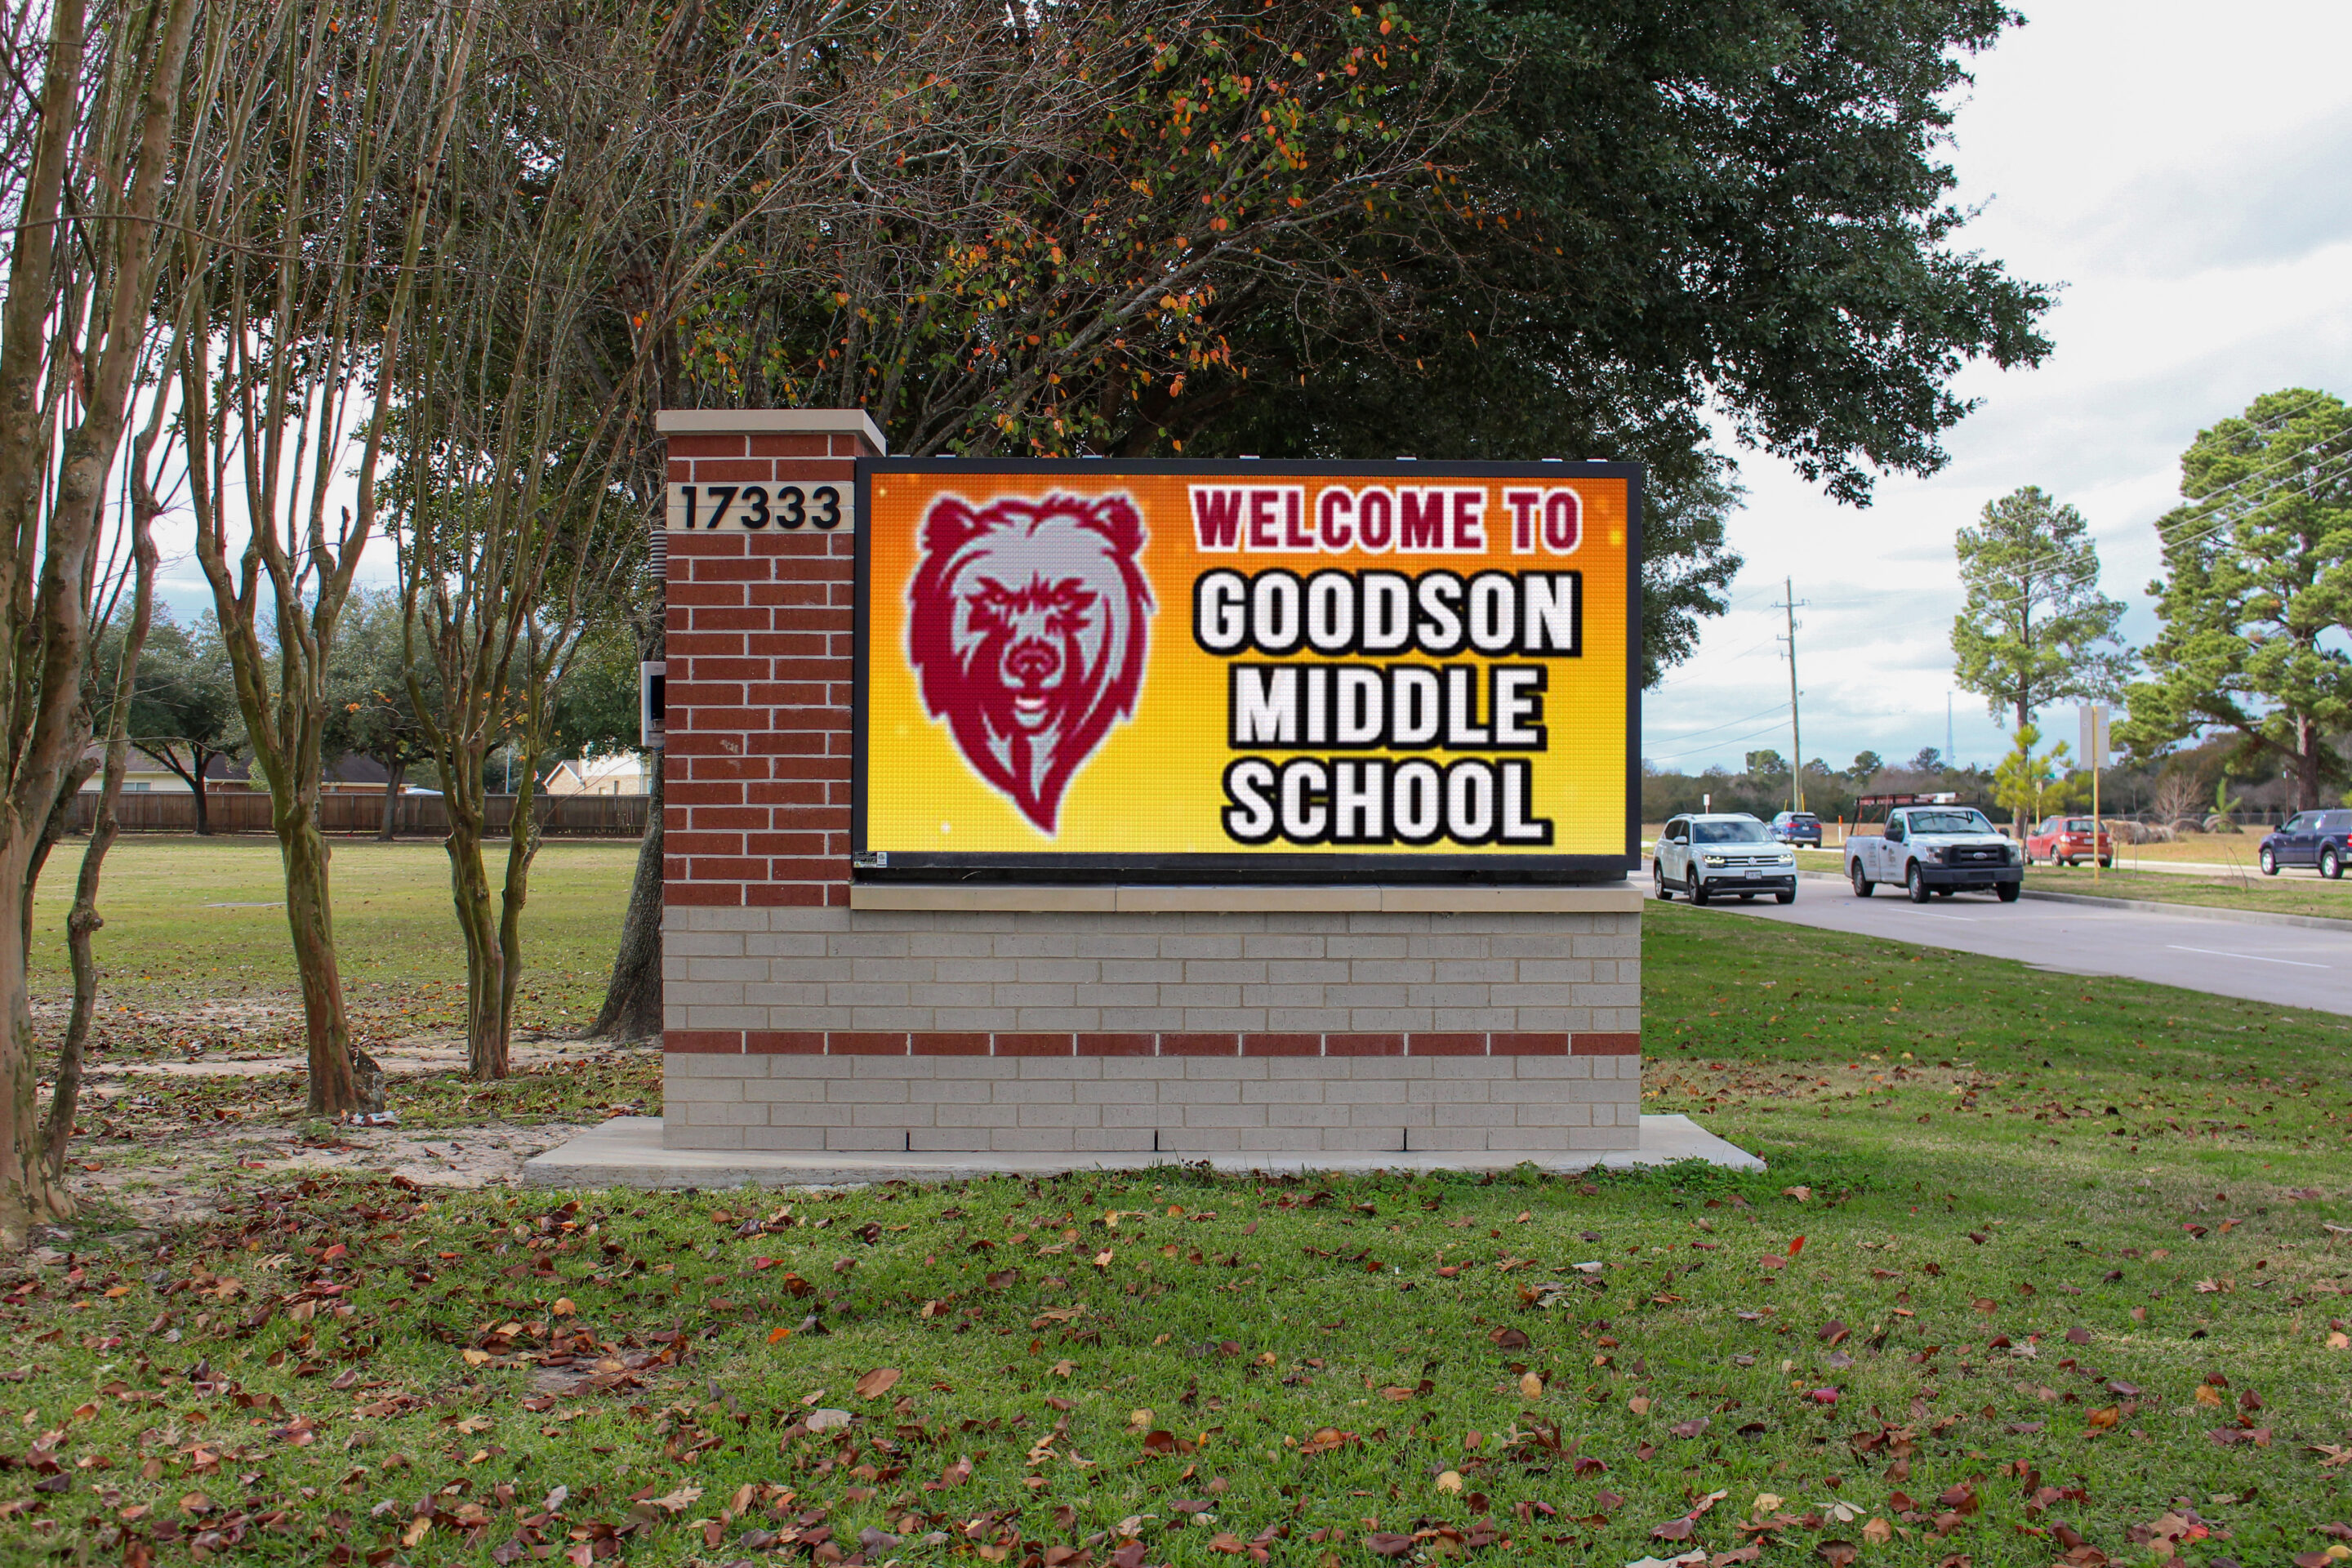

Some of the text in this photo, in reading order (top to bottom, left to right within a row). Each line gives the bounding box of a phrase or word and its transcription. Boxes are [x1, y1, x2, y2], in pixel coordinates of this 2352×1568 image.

[681, 485, 841, 529] 17333
[1192, 488, 1580, 551] WELCOME TO
[1196, 571, 1577, 653] GOODSON
[1232, 666, 1544, 746] MIDDLE
[1225, 758, 1549, 841] SCHOOL
